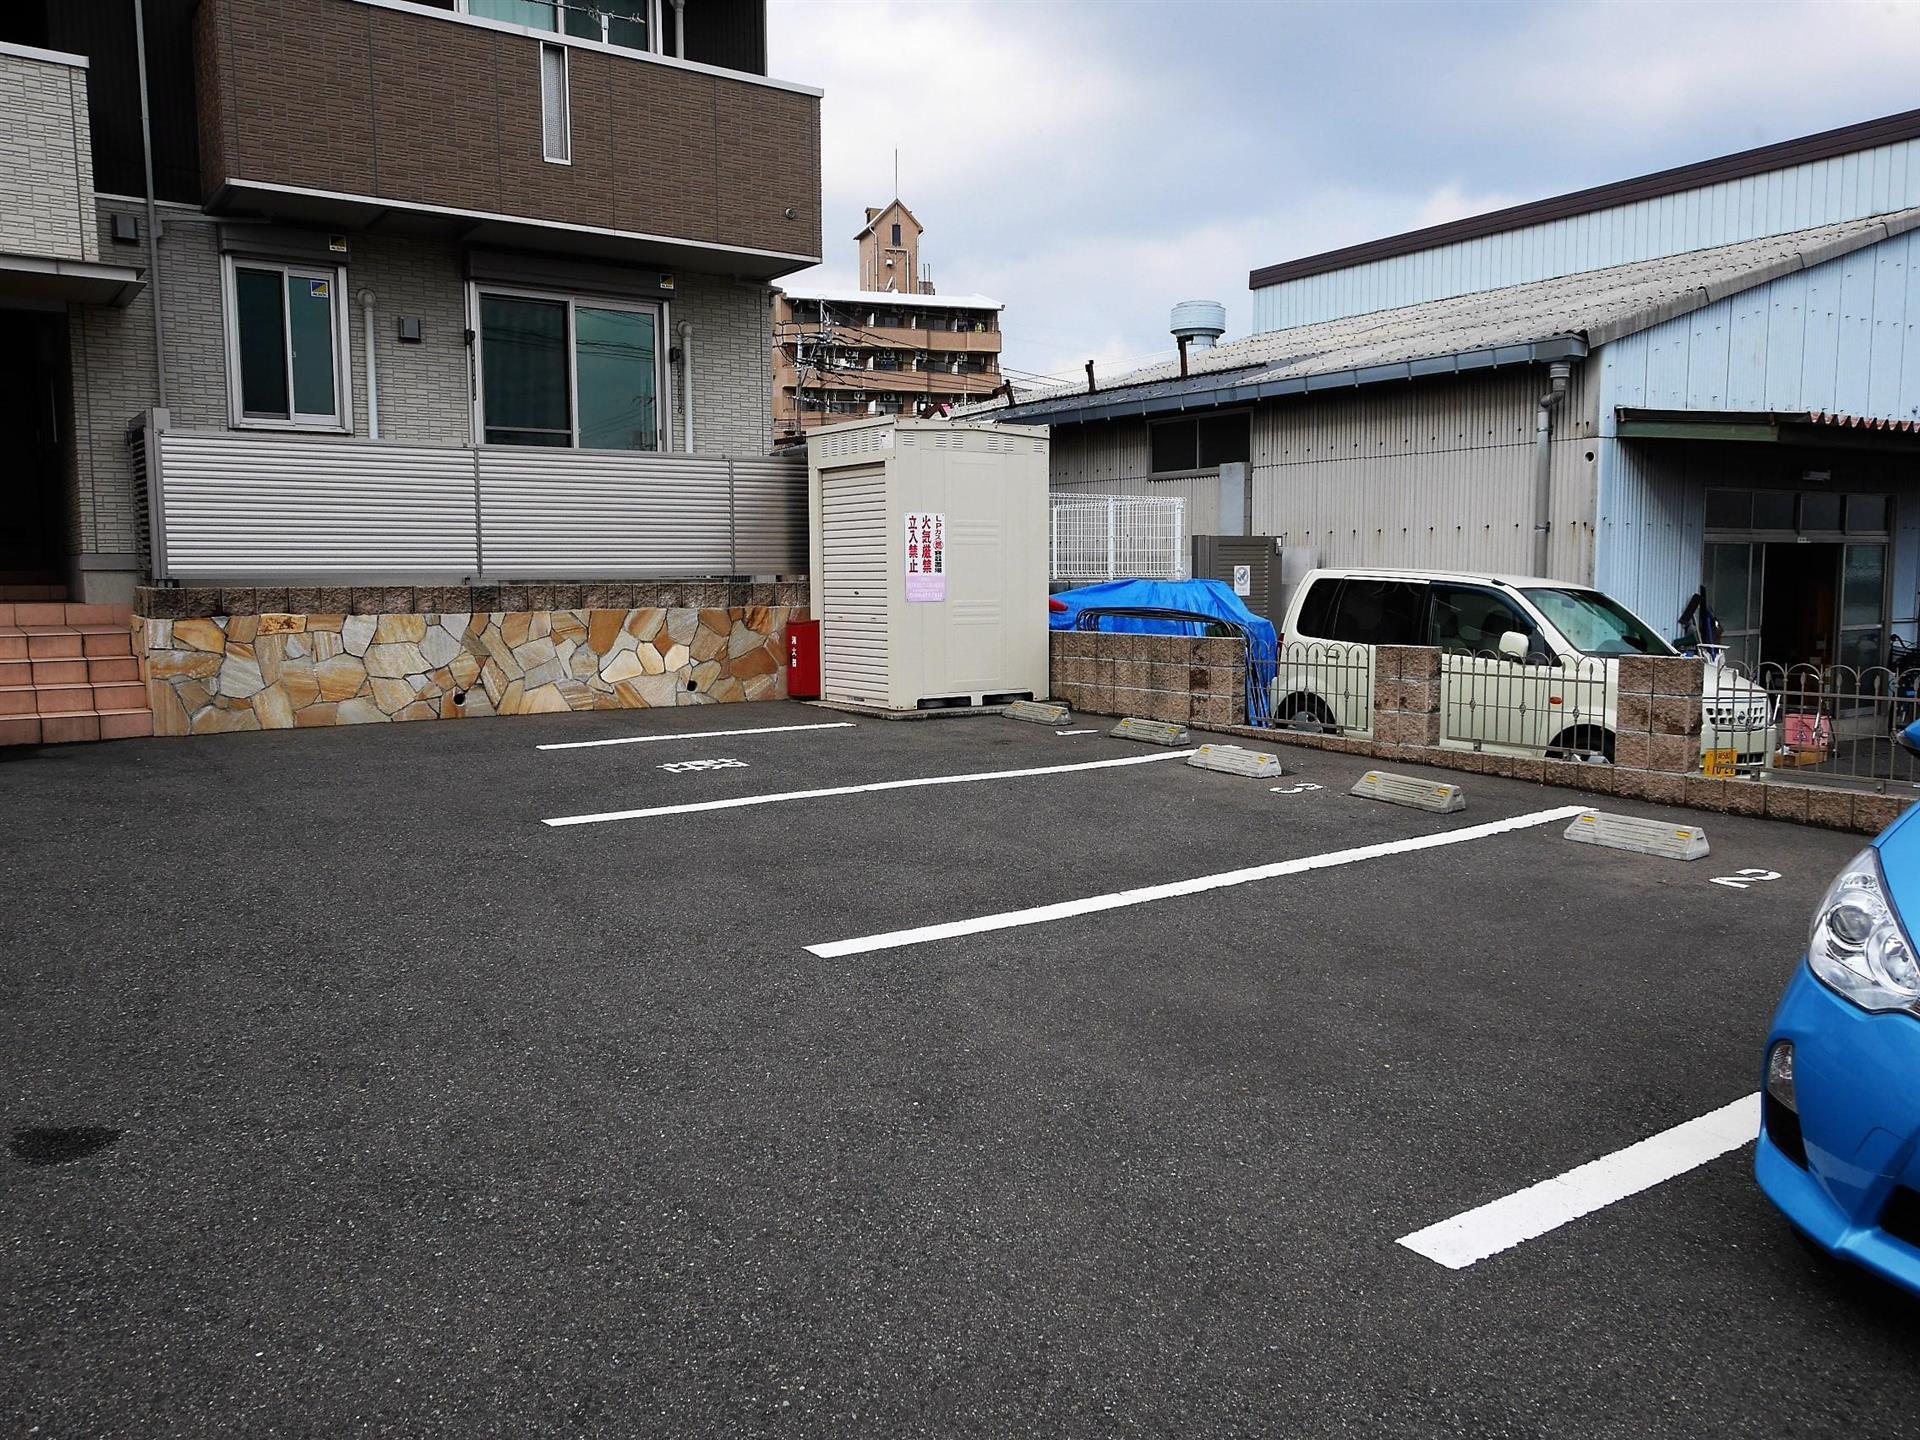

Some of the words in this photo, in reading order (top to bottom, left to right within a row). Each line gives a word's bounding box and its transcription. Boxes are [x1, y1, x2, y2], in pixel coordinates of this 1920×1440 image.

[908, 515, 918, 573] 立入禁止
[922, 515, 932, 573] 火気厳禁
[1269, 782, 1324, 794] 3
[1708, 868, 1782, 889] 2
